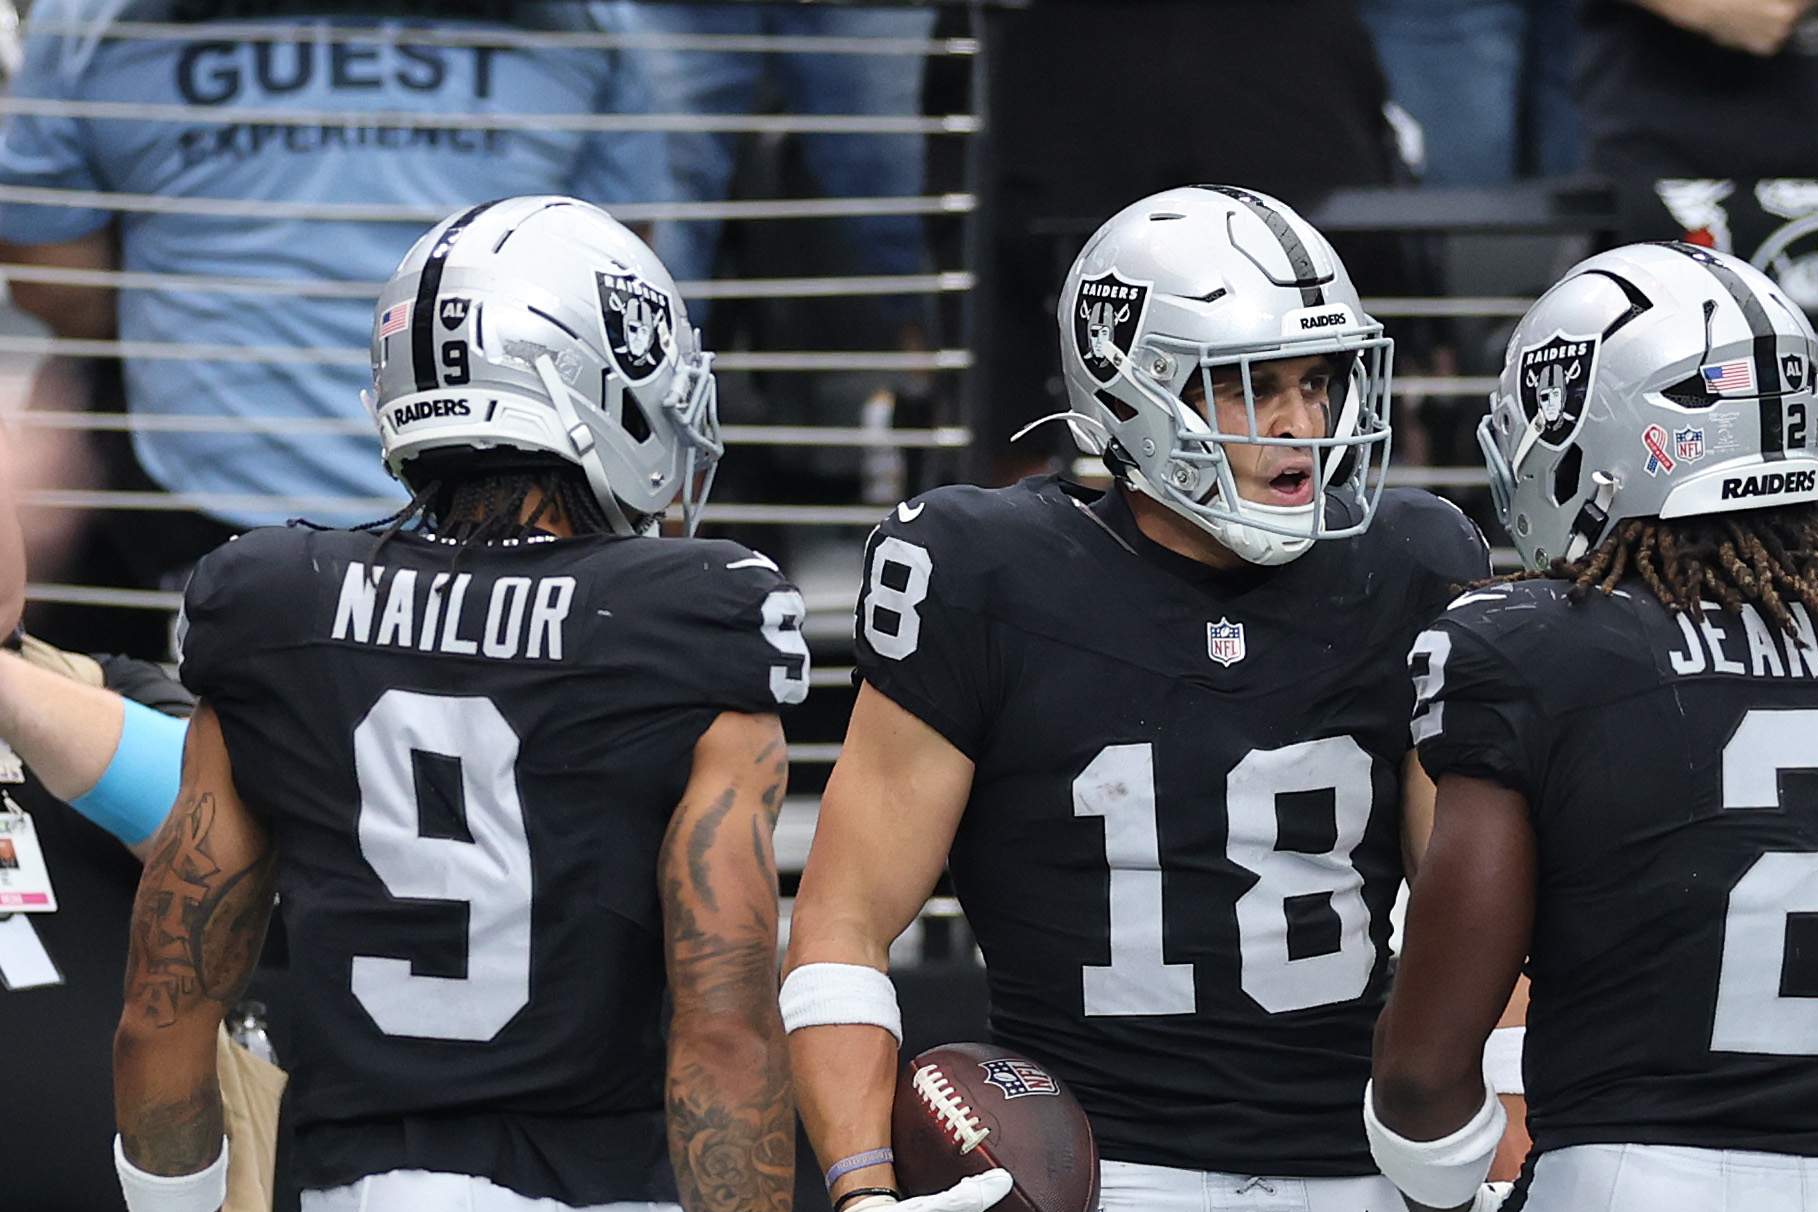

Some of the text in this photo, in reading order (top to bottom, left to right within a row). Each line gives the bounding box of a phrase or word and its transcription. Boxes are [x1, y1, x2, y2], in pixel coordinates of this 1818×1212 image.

[175, 36, 500, 107] GUEST
[1082, 282, 1139, 301] RAIDERS
[442, 302, 465, 318] AL
[1300, 312, 1346, 330] RAIDERS
[441, 340, 471, 385] 9
[1526, 342, 1588, 366] RAIDERS
[1785, 361, 1802, 377] AL
[393, 399, 471, 427] RAIDERS
[1787, 403, 1806, 449] 2
[1679, 438, 1703, 458] NFL
[1721, 469, 1816, 500] RAIDERS
[330, 561, 577, 661] NAILOR
[760, 590, 811, 705] 9
[1214, 639, 1239, 658] NFL
[351, 688, 532, 1043] 9
[1072, 735, 1378, 1017] 18
